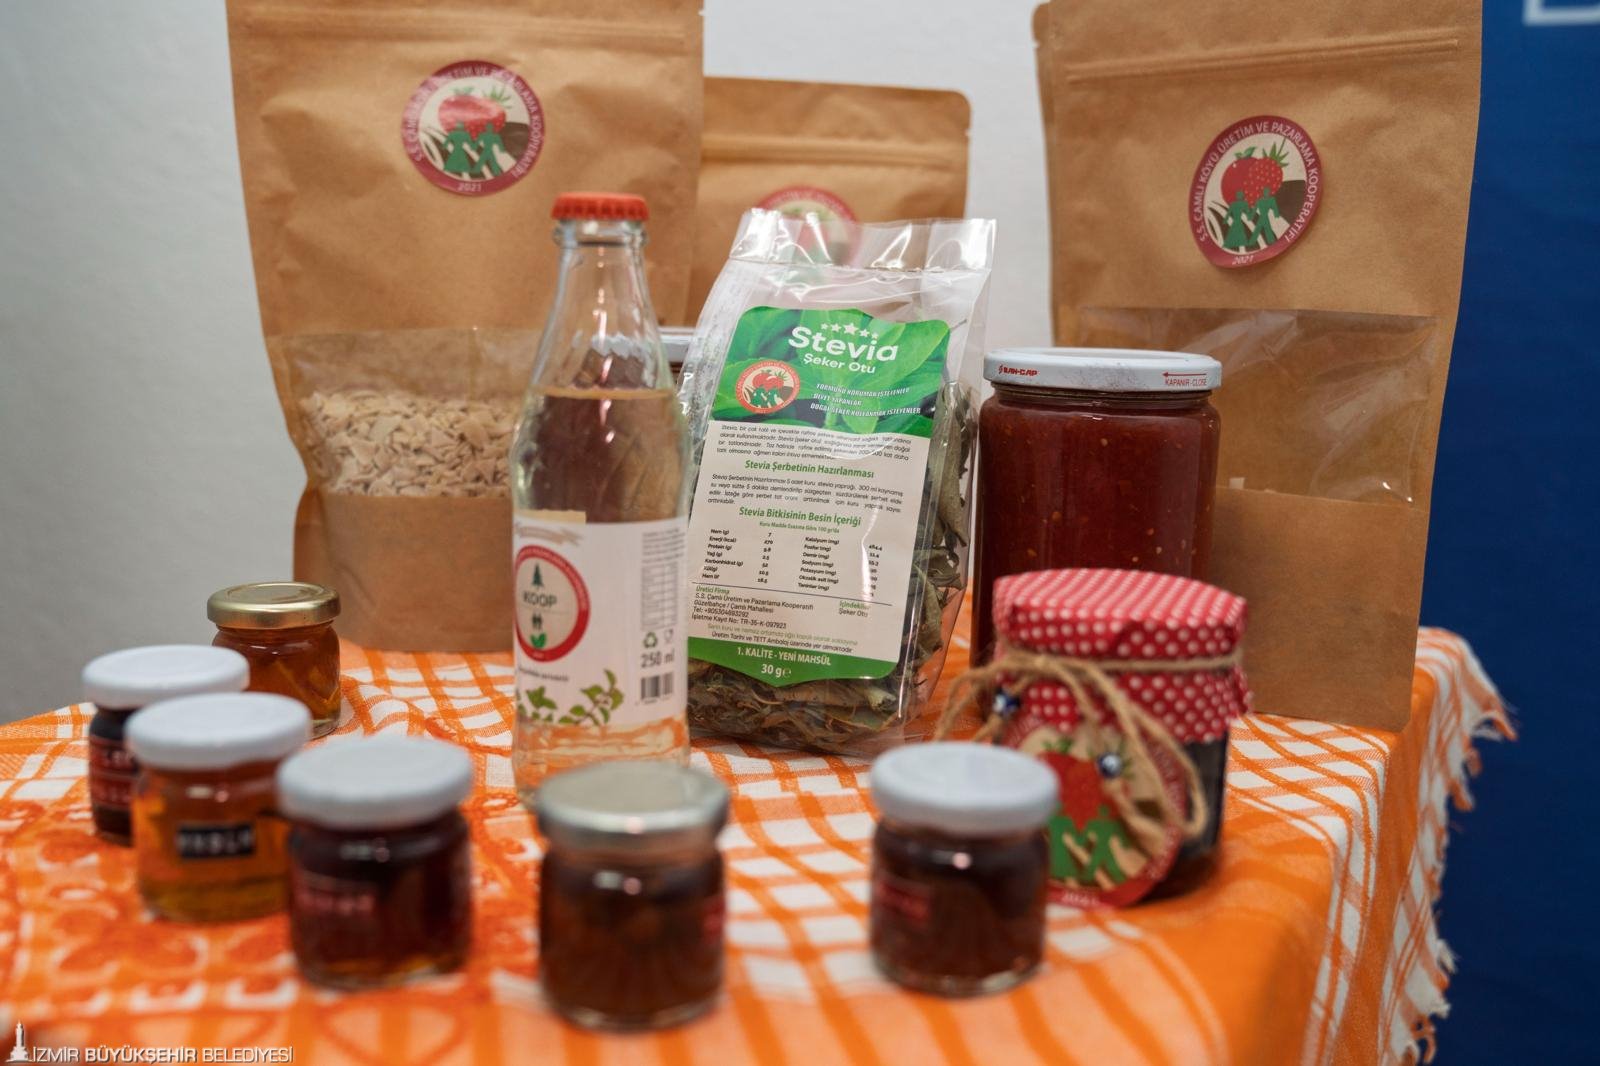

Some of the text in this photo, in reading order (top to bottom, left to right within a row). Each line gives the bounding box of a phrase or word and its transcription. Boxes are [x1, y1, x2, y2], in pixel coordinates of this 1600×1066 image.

[1256, 121, 1270, 132] VE
[1216, 124, 1254, 152] ÜRETİM
[1271, 122, 1314, 166] PAZARLAMA
[458, 183, 482, 192] 2021
[1284, 168, 1319, 242] KOOPERATİFİ
[787, 325, 900, 362] Stevia
[802, 352, 876, 373] Şeker Otu
[745, 459, 874, 478] Stevia Şerbetinin Hazırlanması
[739, 506, 862, 528] Stevia Bitkisinin Besin İçeriği
[523, 590, 558, 608] KOOP
[693, 599, 726, 608] Güzelbahçe
[723, 594, 742, 602] Üretim
[751, 598, 780, 606] Pazarlama
[781, 601, 813, 611] Kooperatifi
[838, 608, 856, 616] Şeker
[641, 651, 662, 669] 250
[737, 646, 744, 655] 1.
[745, 646, 774, 659] KALİTE
[778, 649, 796, 661] YENİ
[797, 651, 832, 665] MAHSÜL
[760, 663, 774, 674] 30
